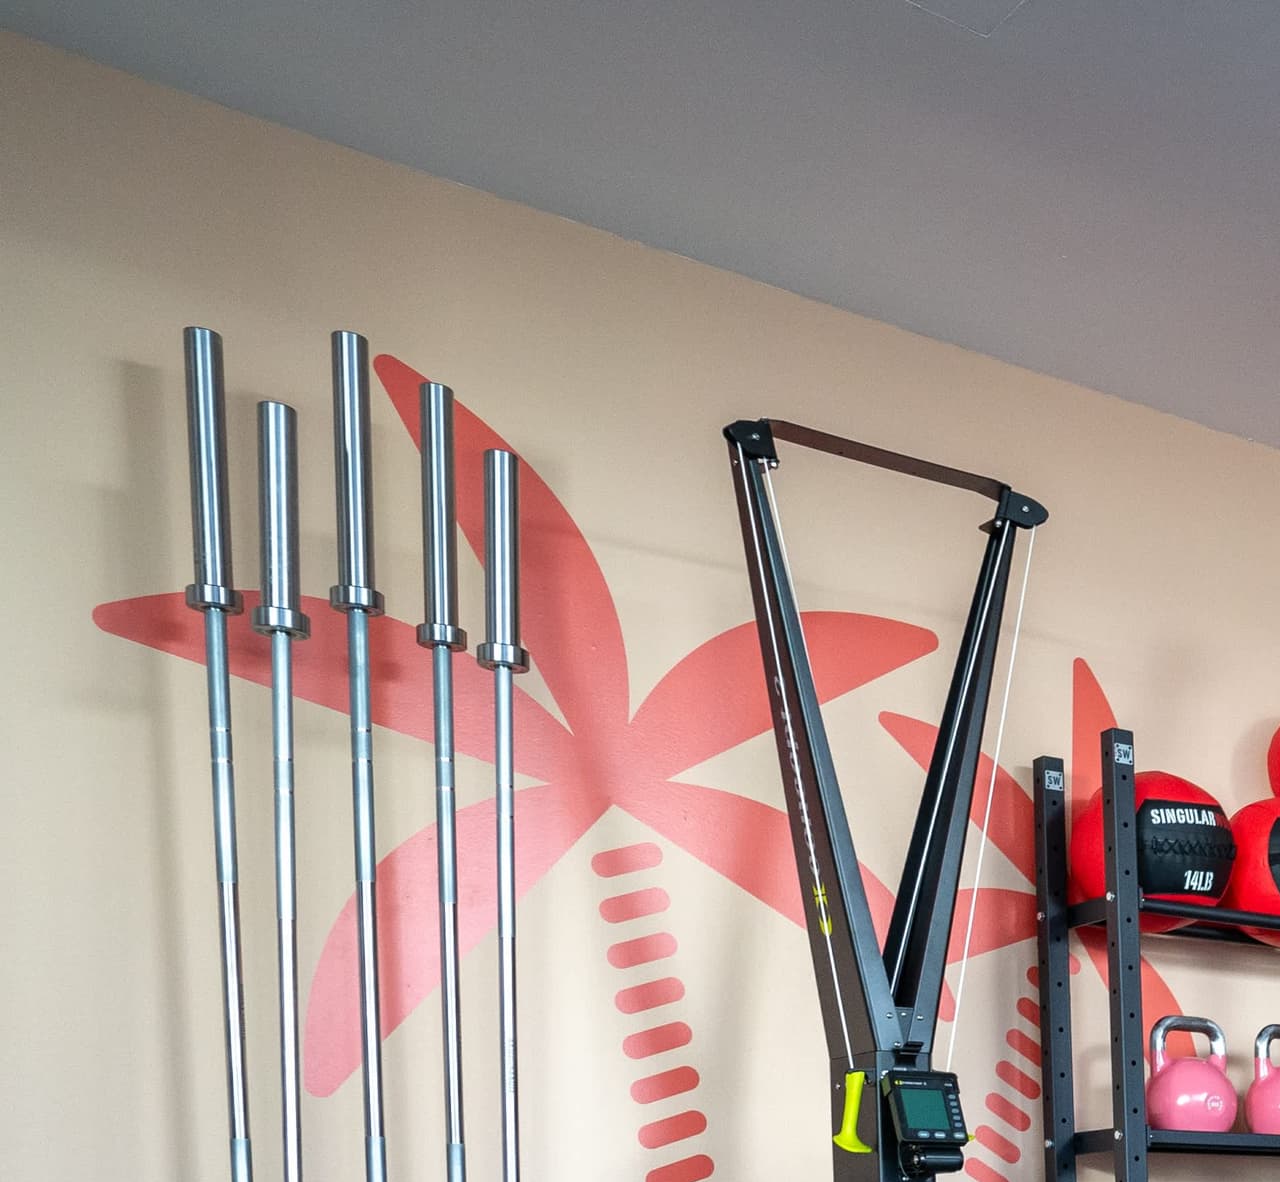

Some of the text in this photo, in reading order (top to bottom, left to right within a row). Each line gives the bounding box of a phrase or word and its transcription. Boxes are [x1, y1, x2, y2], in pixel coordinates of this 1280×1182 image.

[1117, 748, 1131, 760] SW
[1047, 775, 1060, 786] SW
[1184, 870, 1214, 892] 14LB
